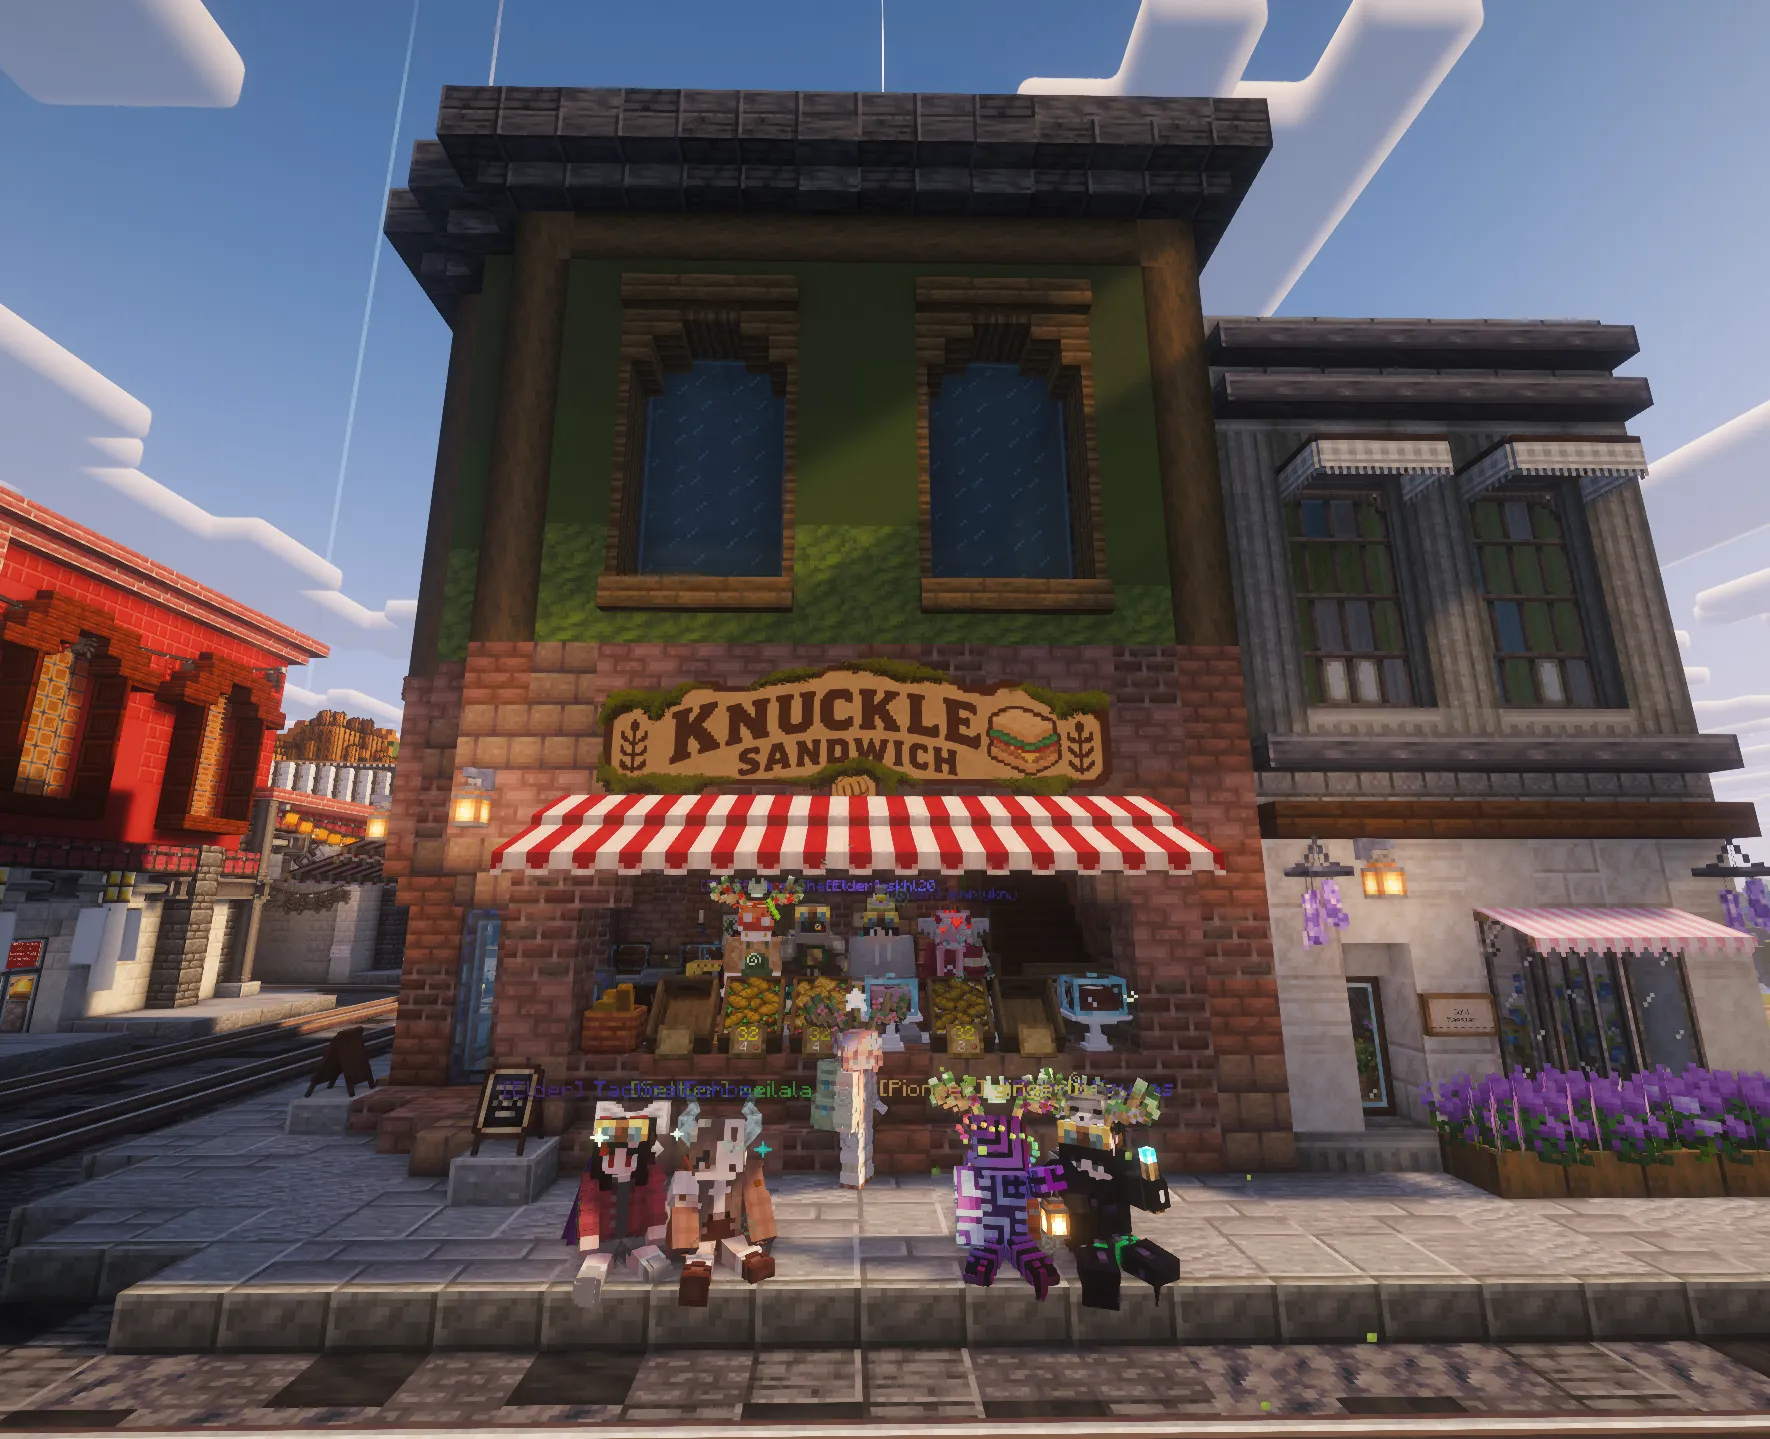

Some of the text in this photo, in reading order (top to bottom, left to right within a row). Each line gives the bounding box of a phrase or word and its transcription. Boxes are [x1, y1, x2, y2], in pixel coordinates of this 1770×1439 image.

[669, 688, 983, 765] KNUCKLE
[738, 738, 958, 777] SANDWICH
[738, 1026, 759, 1040] 32
[810, 1026, 831, 1040] 32
[953, 1025, 975, 1040] 32
[740, 1042, 748, 1052] 4
[812, 1041, 820, 1052] 4
[880, 1079, 985, 1097] [Pion]
